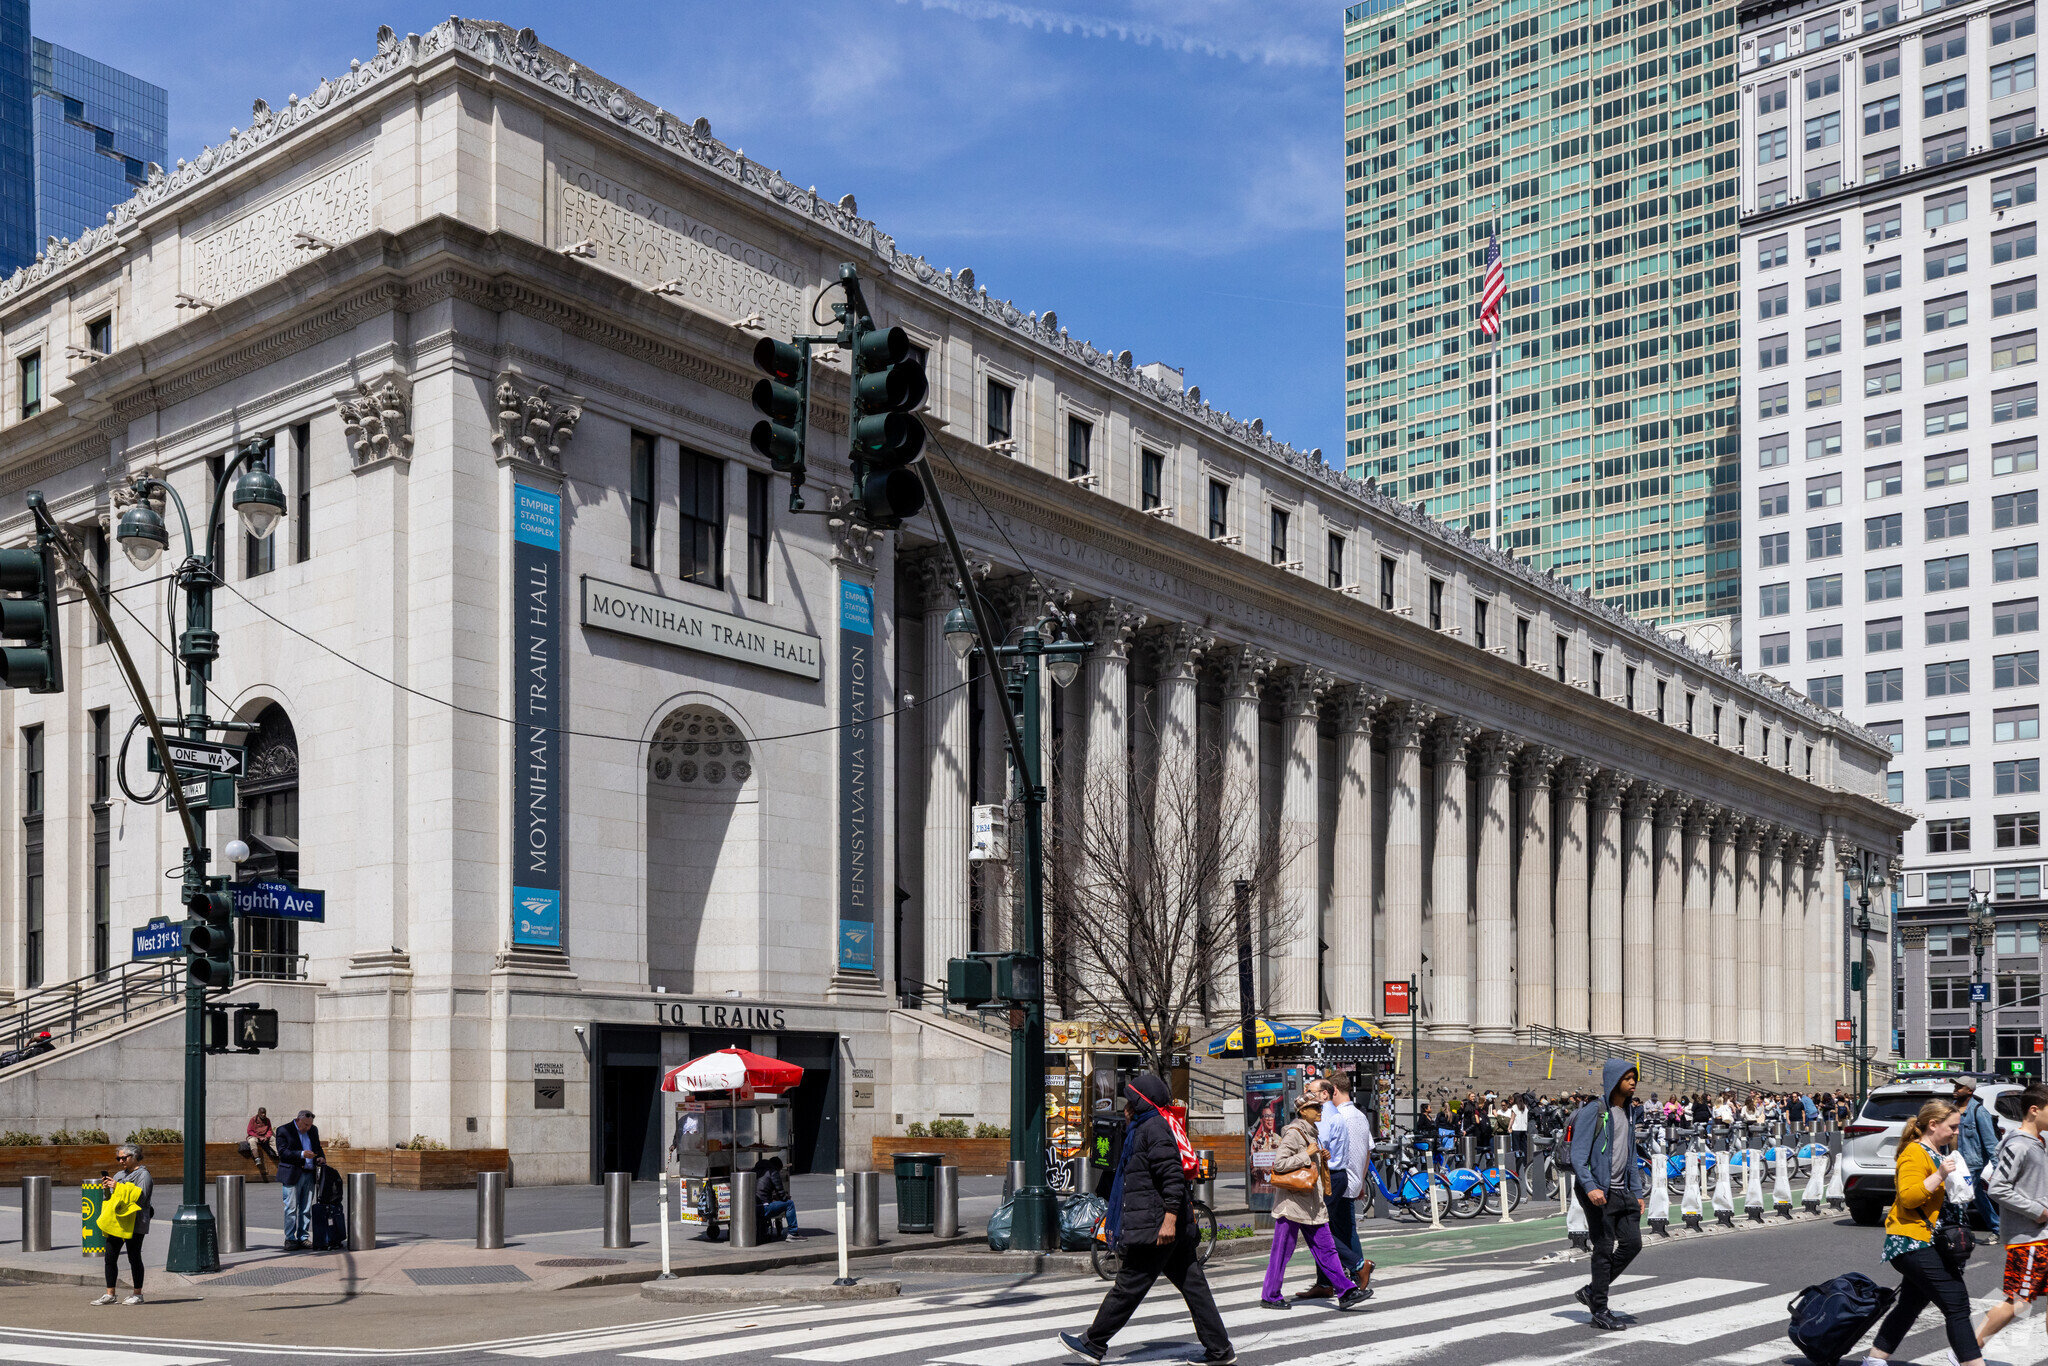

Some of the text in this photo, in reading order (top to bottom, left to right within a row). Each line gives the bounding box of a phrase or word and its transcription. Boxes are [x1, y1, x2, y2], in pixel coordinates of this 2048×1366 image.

[565, 165, 634, 212] LOUIS
[647, 203, 669, 228] XI
[563, 187, 644, 235] CREATED
[649, 224, 682, 254] THE
[690, 242, 738, 279] POSTE
[565, 207, 626, 248] FRANZ
[633, 236, 669, 264] VON
[677, 256, 725, 290] TAXIS
[521, 497, 554, 514] EMPIRE
[521, 510, 555, 526] STATION
[521, 522, 555, 538] COMPLEX
[1030, 525, 1087, 560] SNOW
[1099, 553, 1139, 582] NOR
[1150, 570, 1194, 600] RAIN
[1202, 591, 1238, 618] NOR
[1246, 604, 1285, 634] HEAT
[1292, 624, 1325, 649] NOR
[593, 594, 816, 665] MOYNIHAN TRAIN HALL
[530, 562, 548, 873] MOYNIHAN TRAIN HALL
[175, 749, 232, 766] ONE WAY
[851, 646, 865, 907] PENNSYLVANIA STATION
[190, 784, 203, 795] WAY
[284, 895, 314, 913] Ave
[137, 931, 181, 952] West 31st St
[655, 1003, 786, 1029] TO TRAINS
[1230, 1036, 1272, 1048] SAETT
[2013, 1062, 2023, 1070] TD
